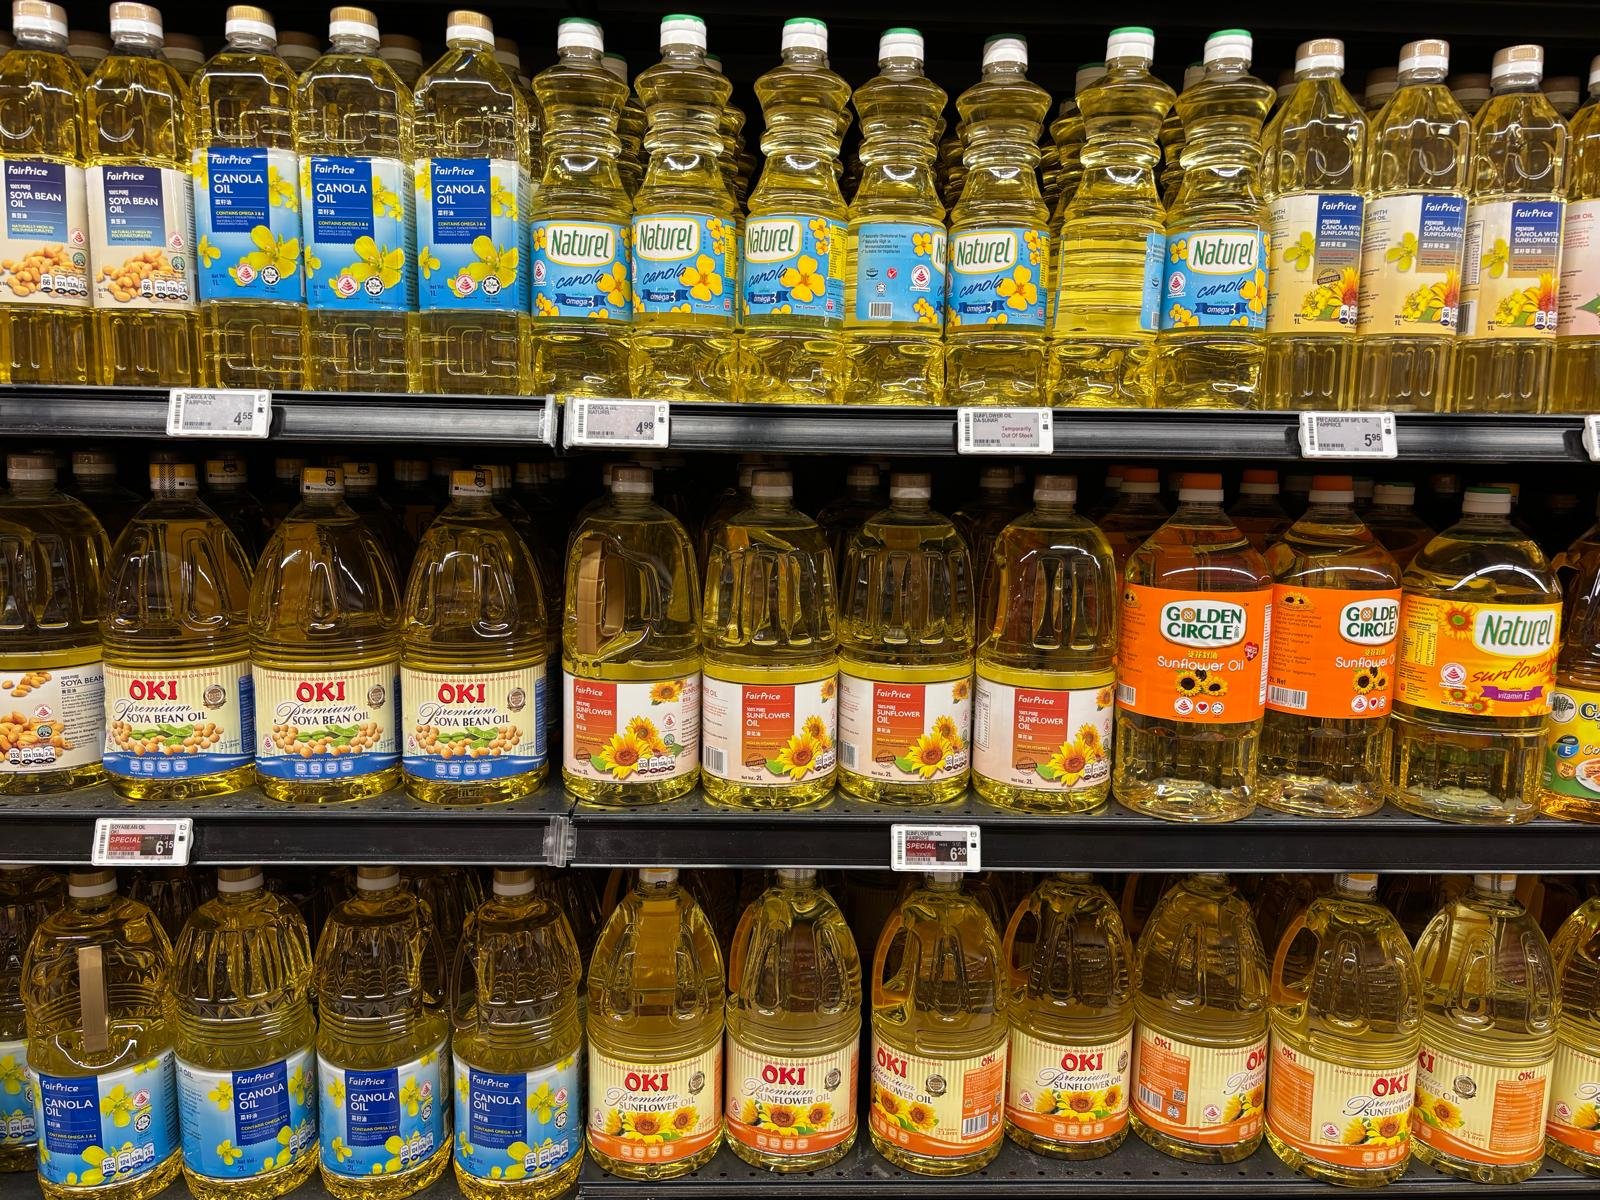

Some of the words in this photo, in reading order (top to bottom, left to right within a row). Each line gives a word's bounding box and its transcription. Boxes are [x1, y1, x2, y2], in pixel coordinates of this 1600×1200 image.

[212, 155, 252, 165] FairPrice
[8, 166, 48, 176] FairPrice
[315, 164, 355, 174] FairPrice
[435, 166, 474, 176] FairPrice
[107, 172, 144, 180] FairPrice
[214, 174, 263, 184] CANOLA
[214, 184, 233, 194] OIL
[316, 183, 367, 193] CANOLA
[437, 185, 485, 194] CANOLA
[10, 192, 33, 200] SOYA
[35, 192, 61, 202] BEAN
[133, 198, 158, 206] BEAN
[317, 194, 336, 204] OIL
[437, 195, 456, 204] OIL
[10, 200, 26, 208] OIL
[1322, 202, 1356, 210] FairPrice
[1425, 202, 1460, 212] FairPrice
[1516, 209, 1553, 218] FairPrice
[639, 224, 693, 252] Naturel
[748, 225, 794, 254] Naturel
[551, 230, 609, 259] Naturel
[957, 237, 1010, 266] Naturel
[1193, 239, 1253, 266] Naturel
[556, 270, 603, 289] canola
[643, 264, 686, 285] canola
[748, 264, 787, 288] canola
[960, 275, 1003, 298] canola
[1197, 277, 1246, 298] canola
[1167, 607, 1242, 623] GOLDEN
[1346, 606, 1398, 621] GOLDEN
[1167, 623, 1232, 640] CIRCLE
[1347, 621, 1394, 637] CIRCLE
[1481, 614, 1552, 646] Naturel
[1157, 656, 1224, 671] Sunflower
[1228, 660, 1244, 671] Oil
[1335, 656, 1388, 668] Sunflower
[1471, 660, 1551, 683] sunflower
[60, 679, 82, 687] SOYA
[85, 675, 104, 684] BEAN
[129, 680, 177, 700] OKI
[296, 681, 345, 702] OKI
[438, 683, 485, 704] OKI
[576, 686, 603, 696] FairPrice
[746, 692, 780, 700] FairPrice
[877, 689, 911, 699] FairPrice
[1524, 692, 1530, 700] E
[1018, 694, 1054, 704] FairPrice
[113, 699, 191, 721] Premium
[274, 702, 356, 725] Premium
[417, 702, 496, 725] Premium
[576, 706, 612, 716] SUNFLOWER
[127, 714, 151, 723] SOYA
[155, 714, 184, 723] BEAN
[188, 712, 207, 721] OIL
[293, 716, 319, 725] SOYA
[323, 715, 350, 724] BEAN
[354, 712, 370, 721] OIL
[435, 717, 459, 726] SOYA
[463, 717, 490, 726] BEAN
[493, 714, 510, 724] OIL
[877, 716, 890, 724] OIL
[1018, 715, 1064, 725] SUNFLOWER
[1565, 746, 1571, 754] E
[1154, 1036, 1171, 1050] OKI
[981, 1054, 996, 1066] OKI
[1282, 1047, 1296, 1062] OKI
[877, 1047, 907, 1078] OKI
[1061, 1053, 1103, 1071] OKI
[184, 1069, 193, 1079] OIL
[237, 1072, 274, 1084] FairPrice
[762, 1064, 806, 1085] OKI
[1036, 1068, 1110, 1086] Premium
[1518, 1071, 1535, 1081] OKI
[42, 1080, 78, 1092] FairPrice
[349, 1077, 385, 1085] FairPrice
[473, 1075, 509, 1089] FairPrice
[625, 1072, 668, 1091] OKI
[741, 1078, 815, 1096] Premium
[1054, 1081, 1109, 1091] SUNFLOWER
[1111, 1075, 1122, 1085] OIL
[1372, 1073, 1409, 1097] OKI
[239, 1083, 284, 1100] CANOLA
[350, 1092, 395, 1102] CANOLA
[605, 1088, 678, 1106] Premium
[44, 1098, 93, 1109] CANOLA
[474, 1092, 520, 1105] CANOLA
[756, 1092, 812, 1104] SUNFLOWER
[816, 1093, 830, 1102] OIL
[917, 1094, 932, 1104] OIL
[1443, 1092, 1460, 1105] OIL
[240, 1100, 259, 1110] OIL
[351, 1102, 368, 1111] OIL
[474, 1101, 490, 1112] OIL
[619, 1102, 677, 1112] SUNFLOWER
[681, 1097, 695, 1106] OIL
[46, 1107, 62, 1117] OIL
